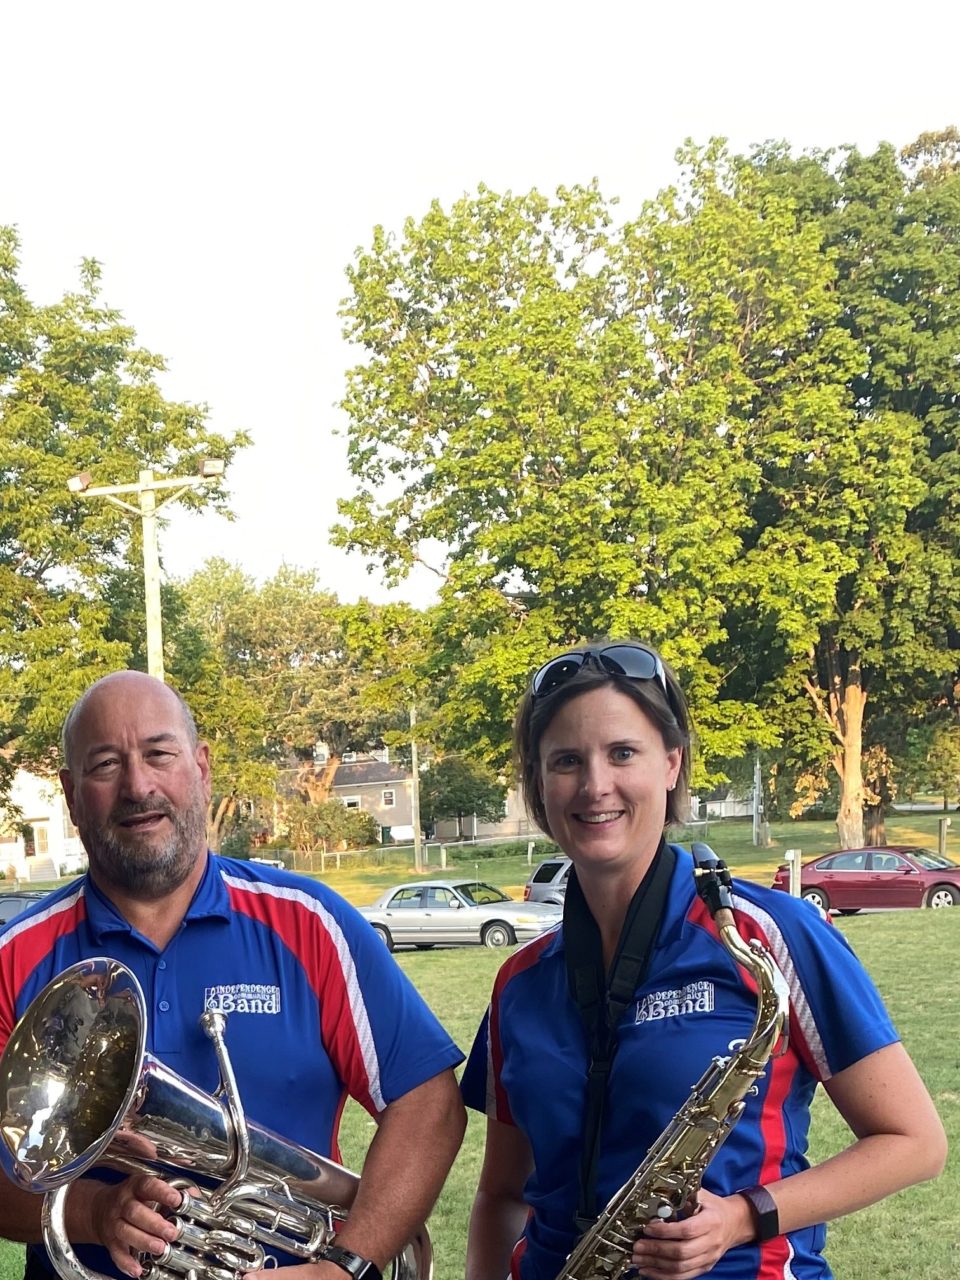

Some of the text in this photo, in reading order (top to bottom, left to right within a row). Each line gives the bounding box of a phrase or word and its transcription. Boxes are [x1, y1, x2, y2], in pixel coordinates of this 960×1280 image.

[216, 984, 276, 994] INDEPENDENCE
[218, 993, 277, 1014] Band
[645, 990, 711, 1021] Band
